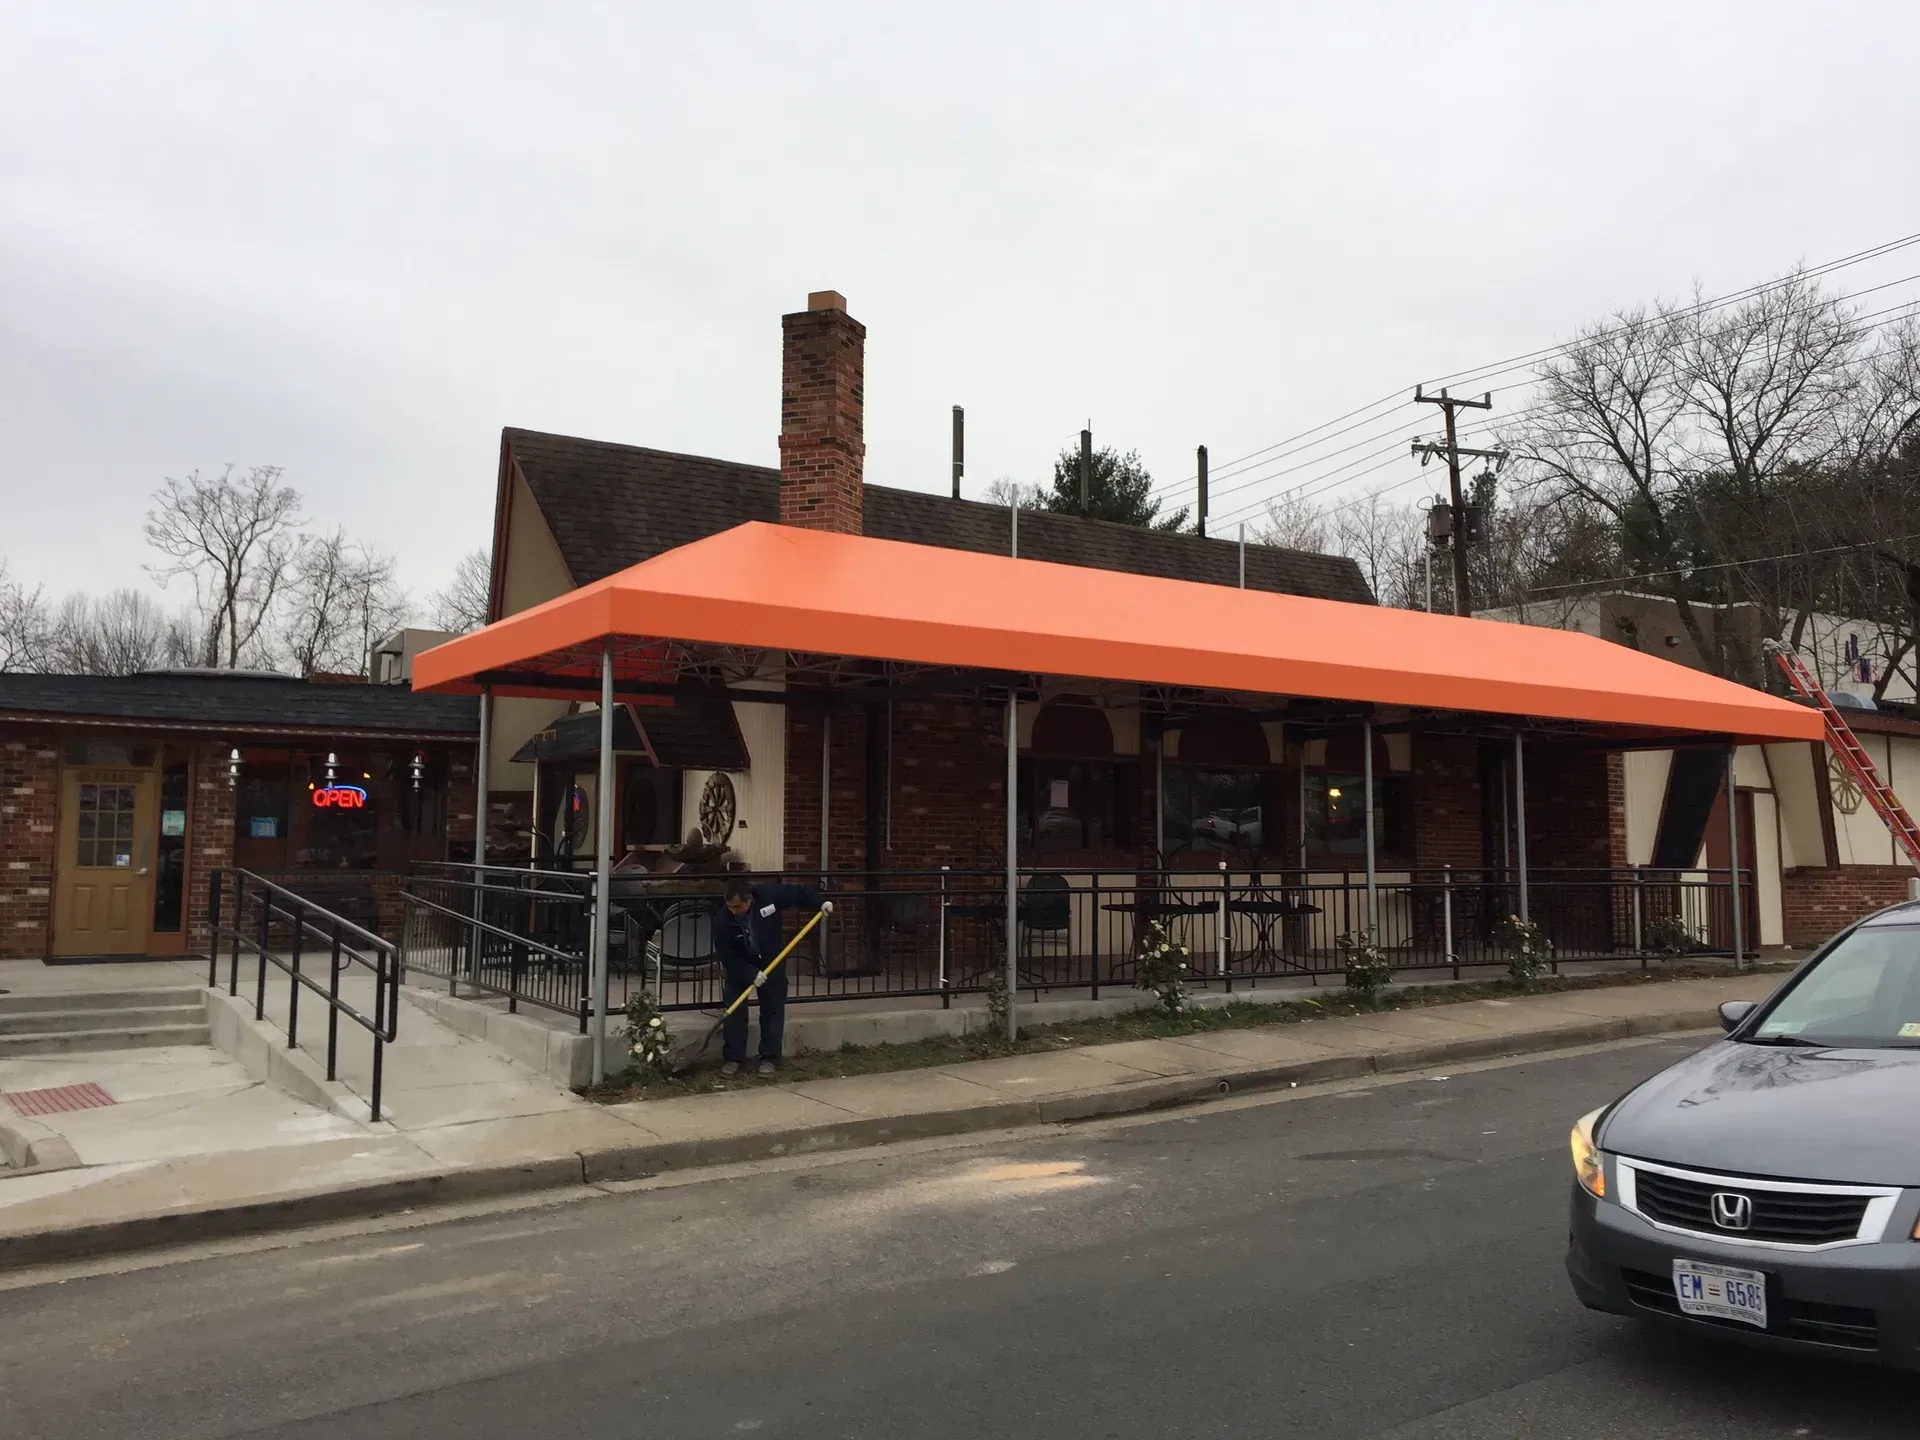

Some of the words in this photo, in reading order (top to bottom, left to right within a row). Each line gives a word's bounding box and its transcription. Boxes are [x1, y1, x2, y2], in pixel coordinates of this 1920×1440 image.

[313, 788, 363, 808] OPEN
[1679, 1273, 1704, 1300] EM
[1726, 1280, 1762, 1312] 6585
